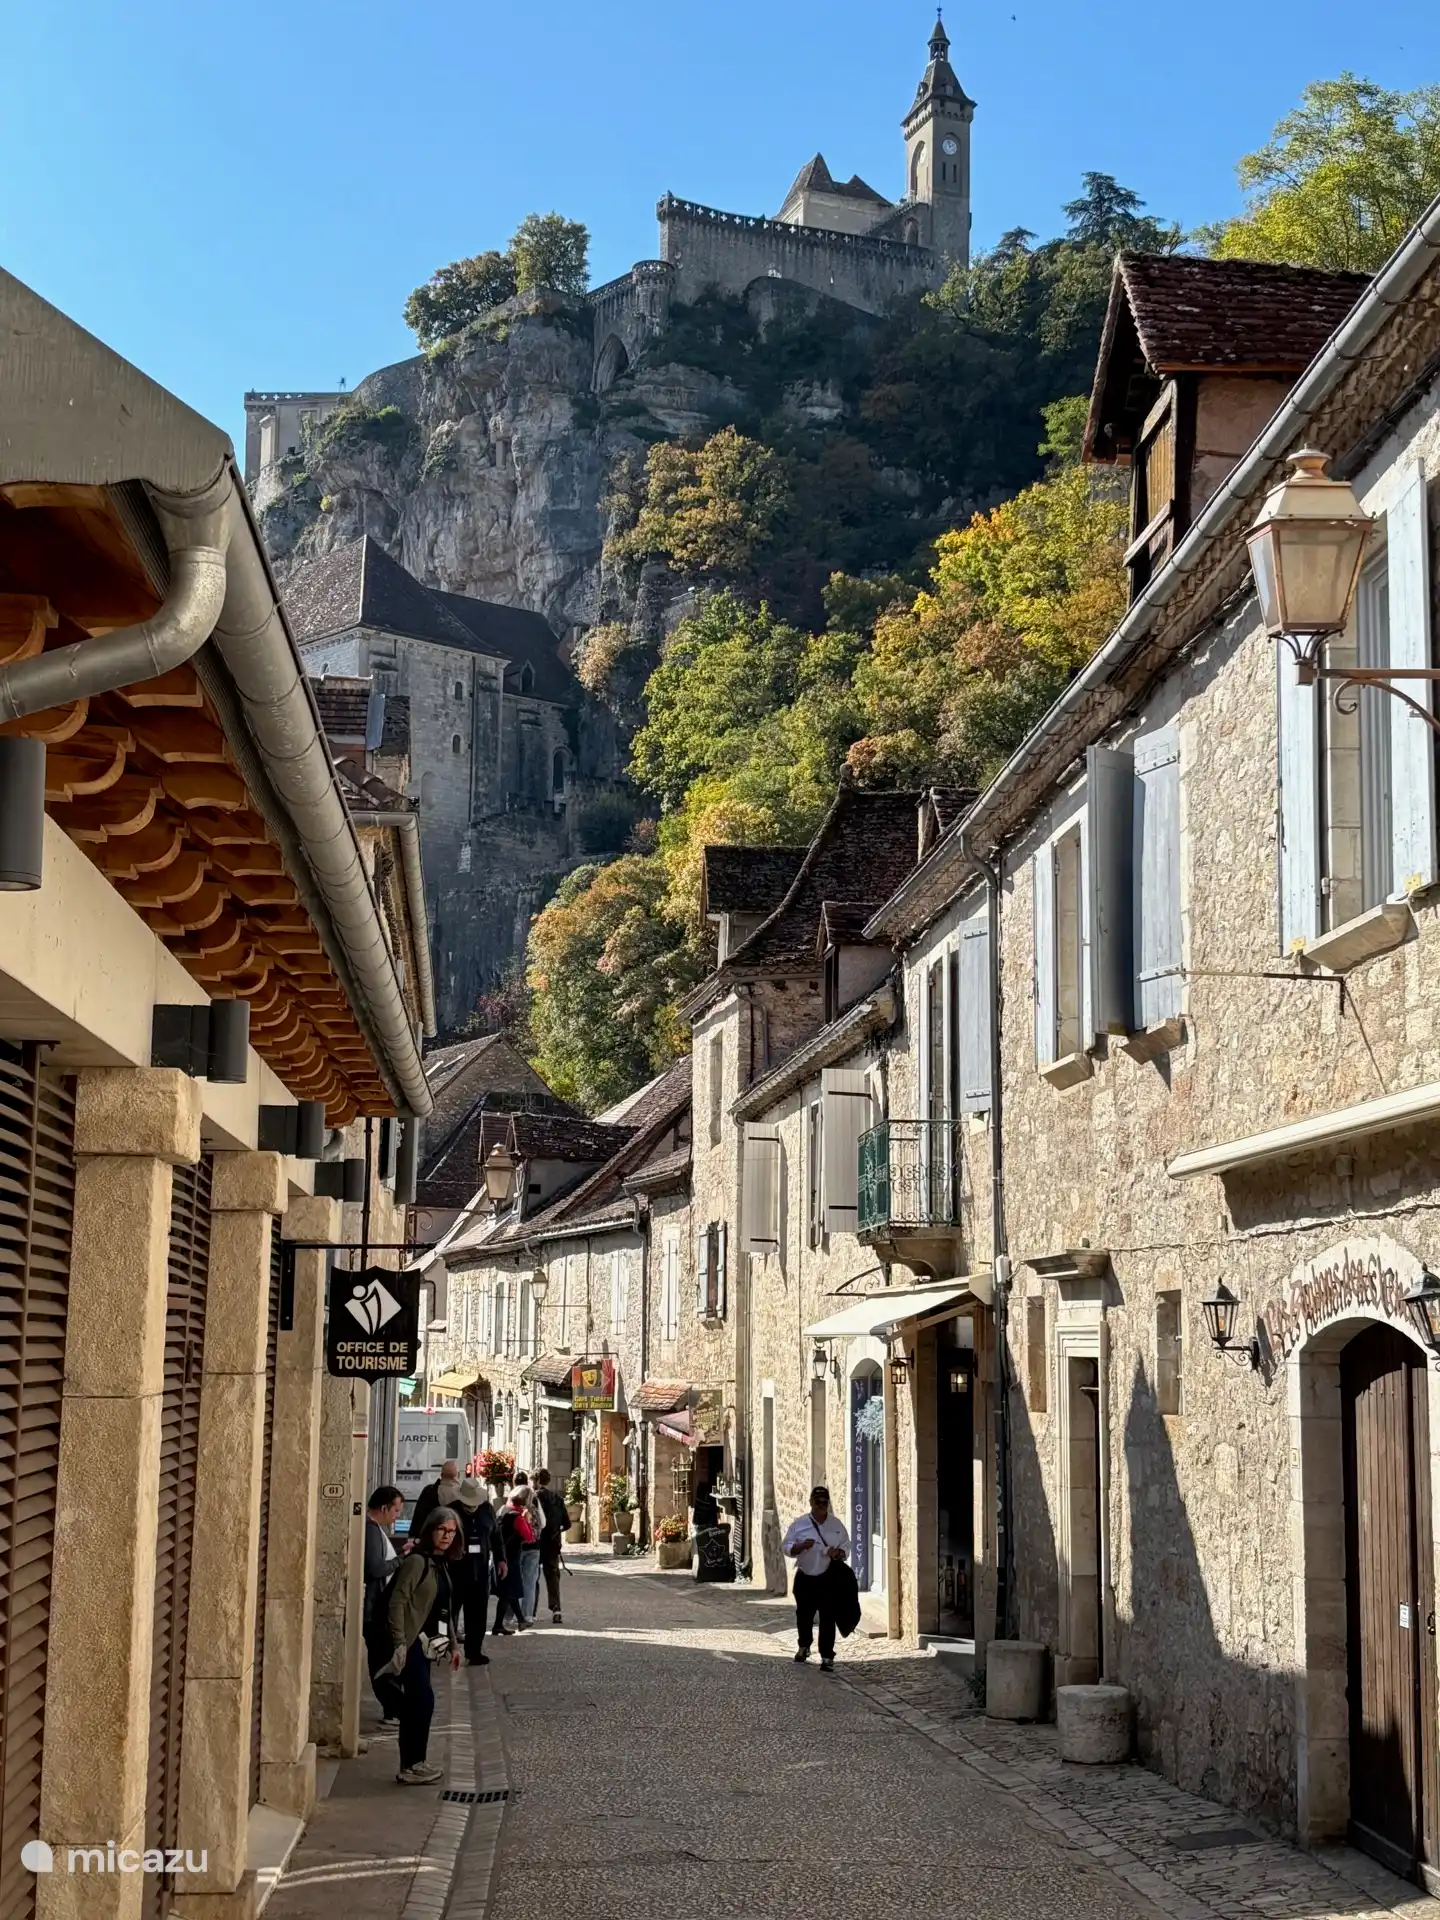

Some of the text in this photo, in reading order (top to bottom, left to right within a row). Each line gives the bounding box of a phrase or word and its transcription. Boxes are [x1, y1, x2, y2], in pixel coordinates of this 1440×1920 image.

[336, 1341, 408, 1353] OFFICE DE
[336, 1355, 408, 1370] TOURISME
[328, 1486, 339, 1495] 61
[854, 1483, 864, 1493] du
[855, 1503, 863, 1561] QUERCY
